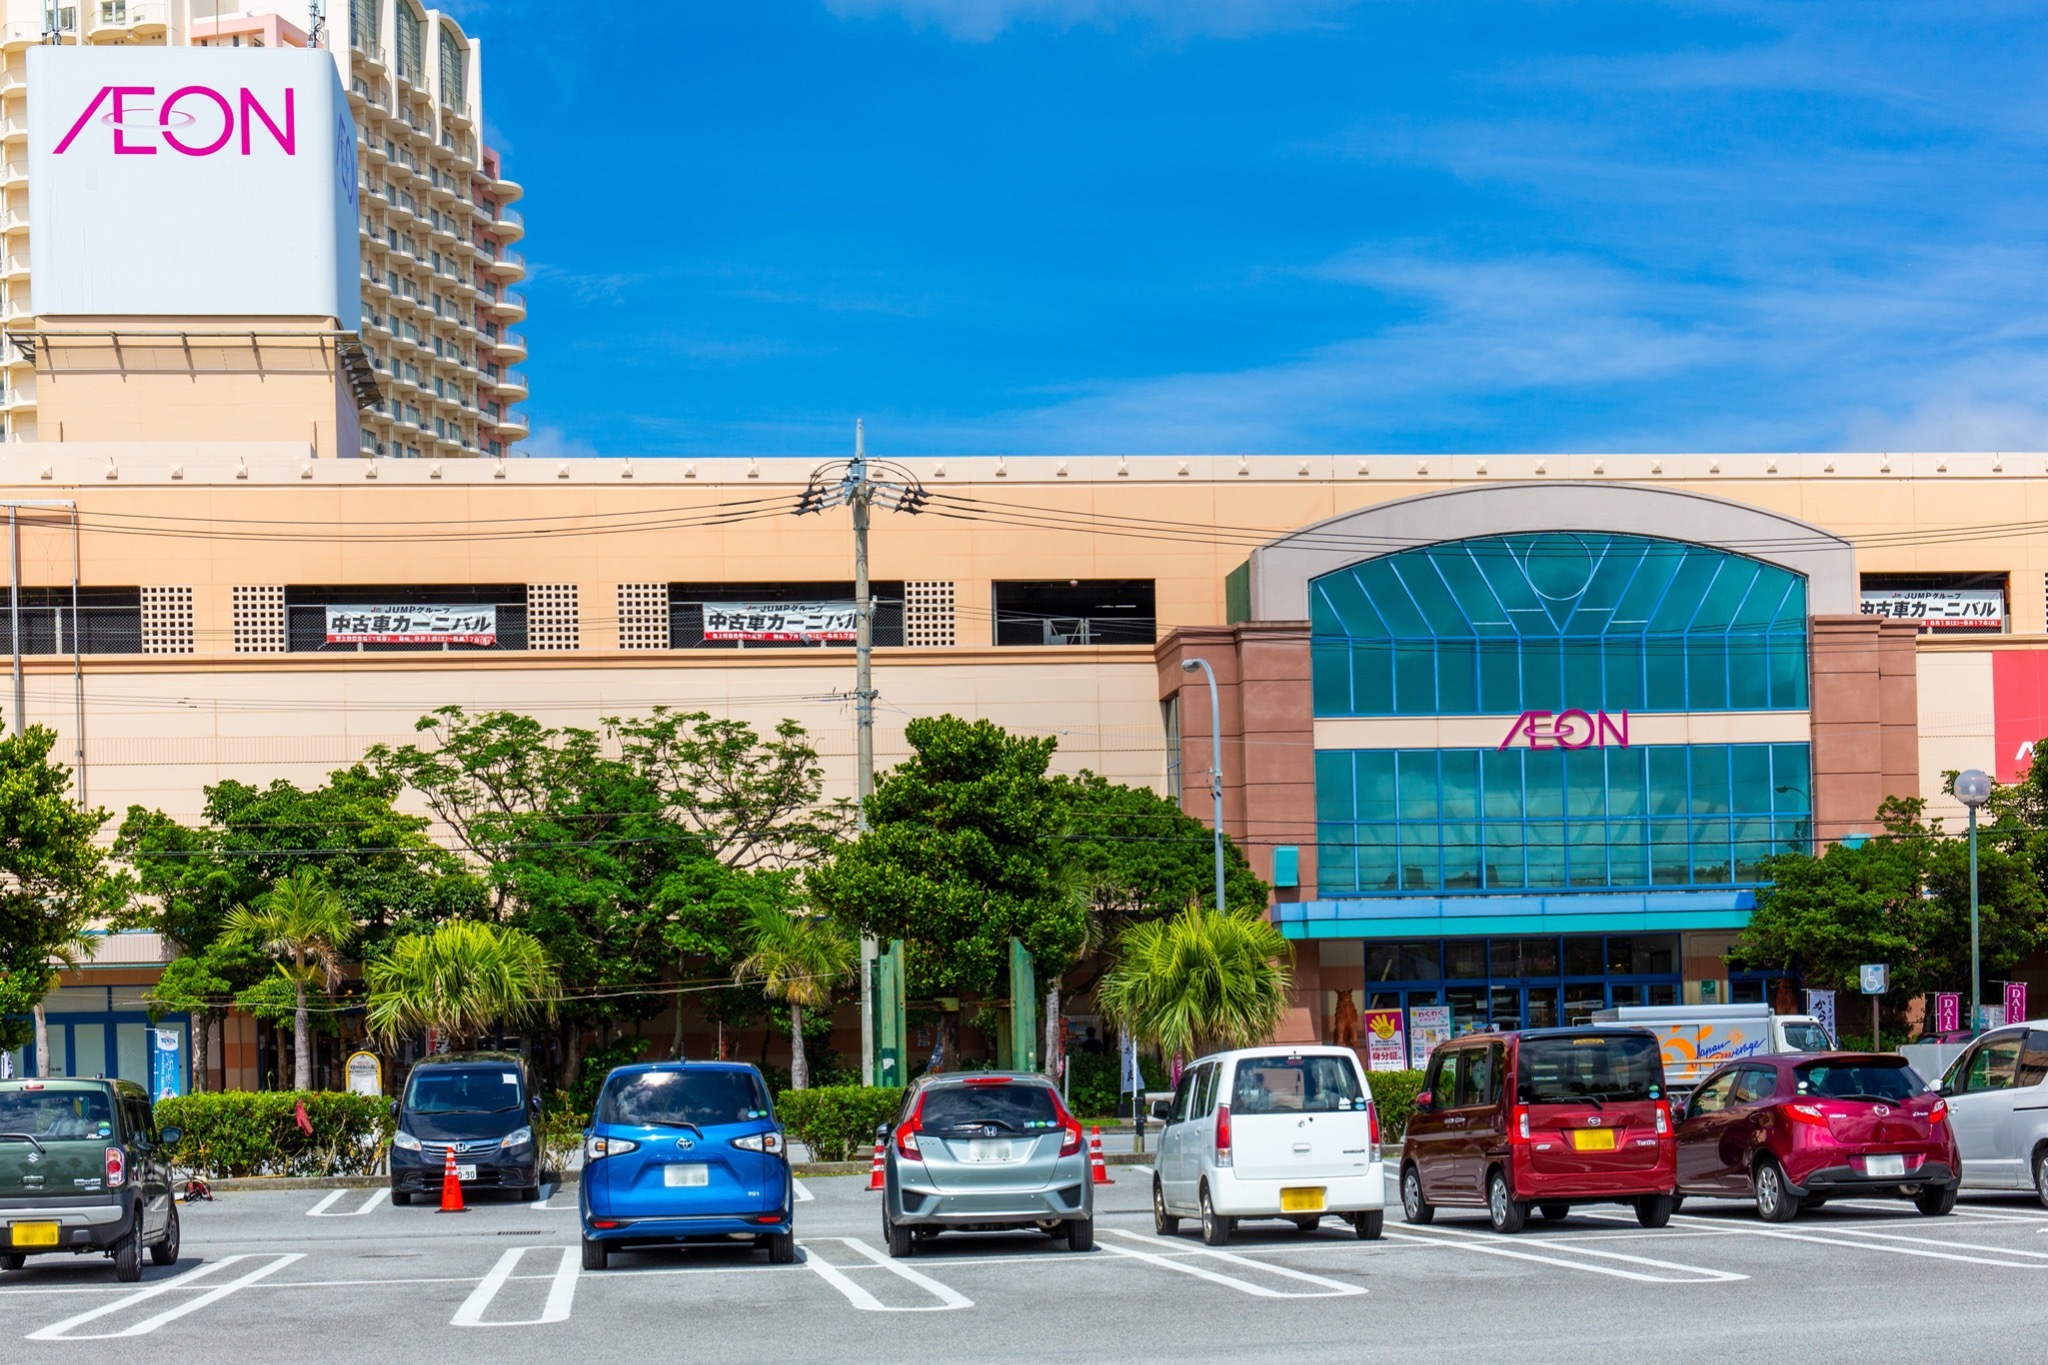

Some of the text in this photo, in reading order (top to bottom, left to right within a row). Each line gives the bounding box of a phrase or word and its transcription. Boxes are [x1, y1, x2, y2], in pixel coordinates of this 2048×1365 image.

[385, 606, 451, 614] JUMPグループ
[1861, 601, 1997, 618] 中古車カーニバル
[331, 615, 492, 634] 中古車カーニバル
[1944, 999, 1953, 1031] DAIS
[2012, 989, 2021, 1023] DAIS
[1372, 1052, 1398, 1060] 身分証
[1692, 1039, 1731, 1068] Japan
